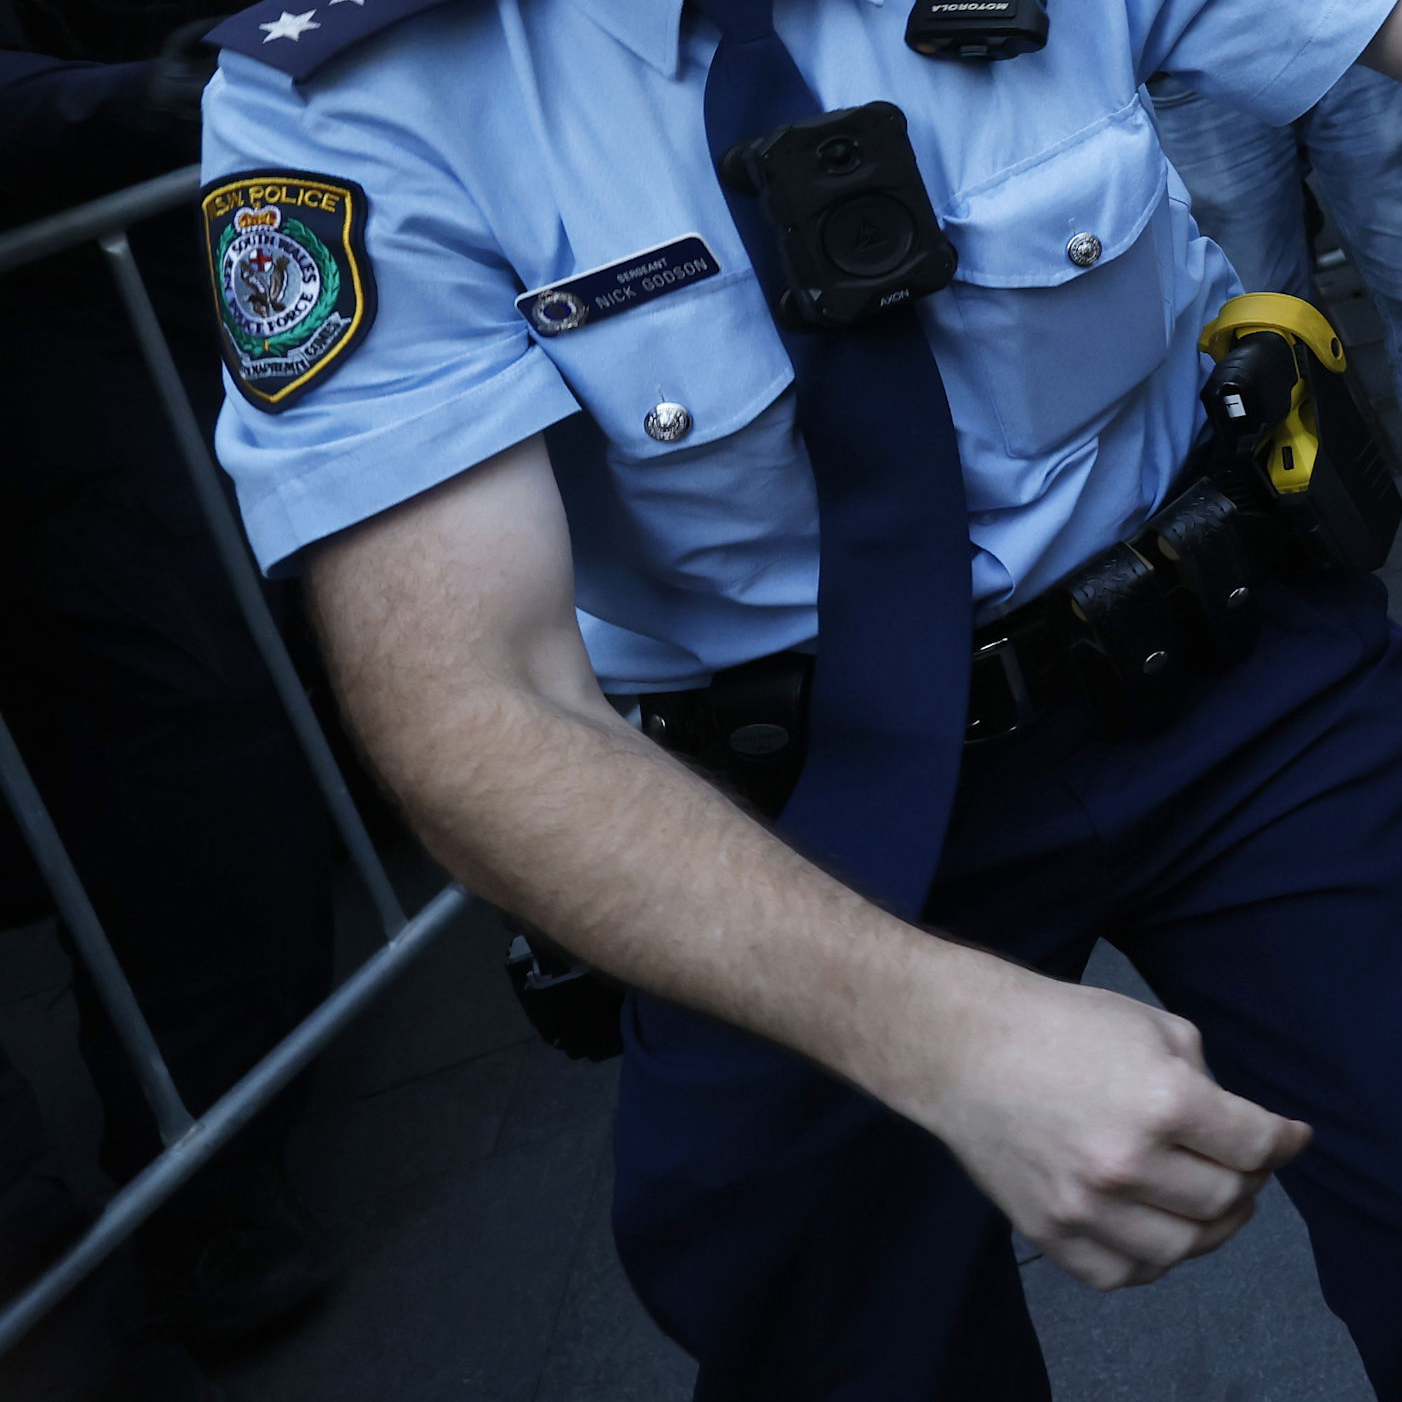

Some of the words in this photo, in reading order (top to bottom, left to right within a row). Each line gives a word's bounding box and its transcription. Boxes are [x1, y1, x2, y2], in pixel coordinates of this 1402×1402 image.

[931, 2, 1010, 13] MOTOROLA
[248, 185, 341, 213] POLICE
[232, 234, 275, 253] SOUTH
[277, 240, 318, 285] WALES
[616, 258, 668, 285] SERGEANT
[595, 285, 638, 310] NICK
[641, 258, 708, 293] GODSON
[880, 287, 910, 308] AXON
[266, 293, 314, 333] FORCE
